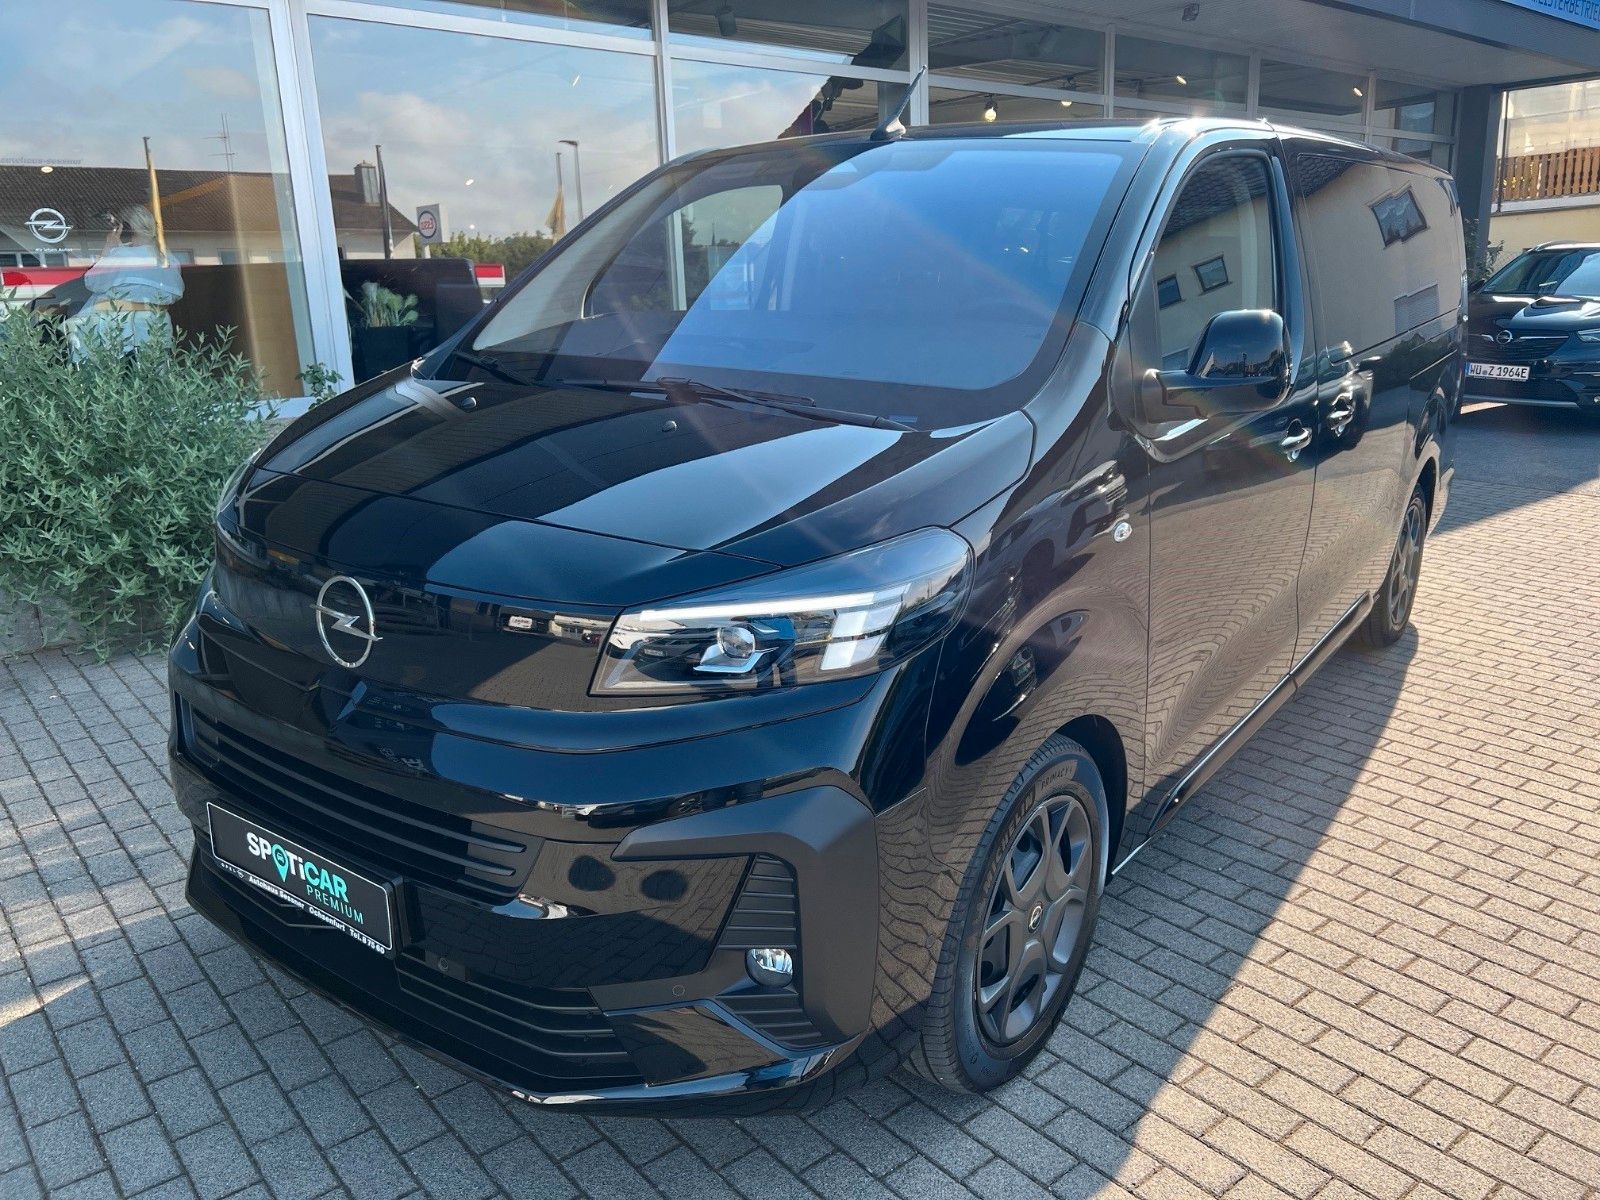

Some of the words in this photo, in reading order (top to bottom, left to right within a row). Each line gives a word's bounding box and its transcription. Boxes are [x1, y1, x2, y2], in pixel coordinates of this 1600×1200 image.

[1531, 0, 1600, 22] TERBETRIE
[1488, 367, 1494, 376] Z
[1497, 367, 1528, 379] 1964E
[249, 875, 278, 895] Autohaus
[309, 906, 346, 932] Ochsenfurt
[306, 884, 364, 925] PREMIUM
